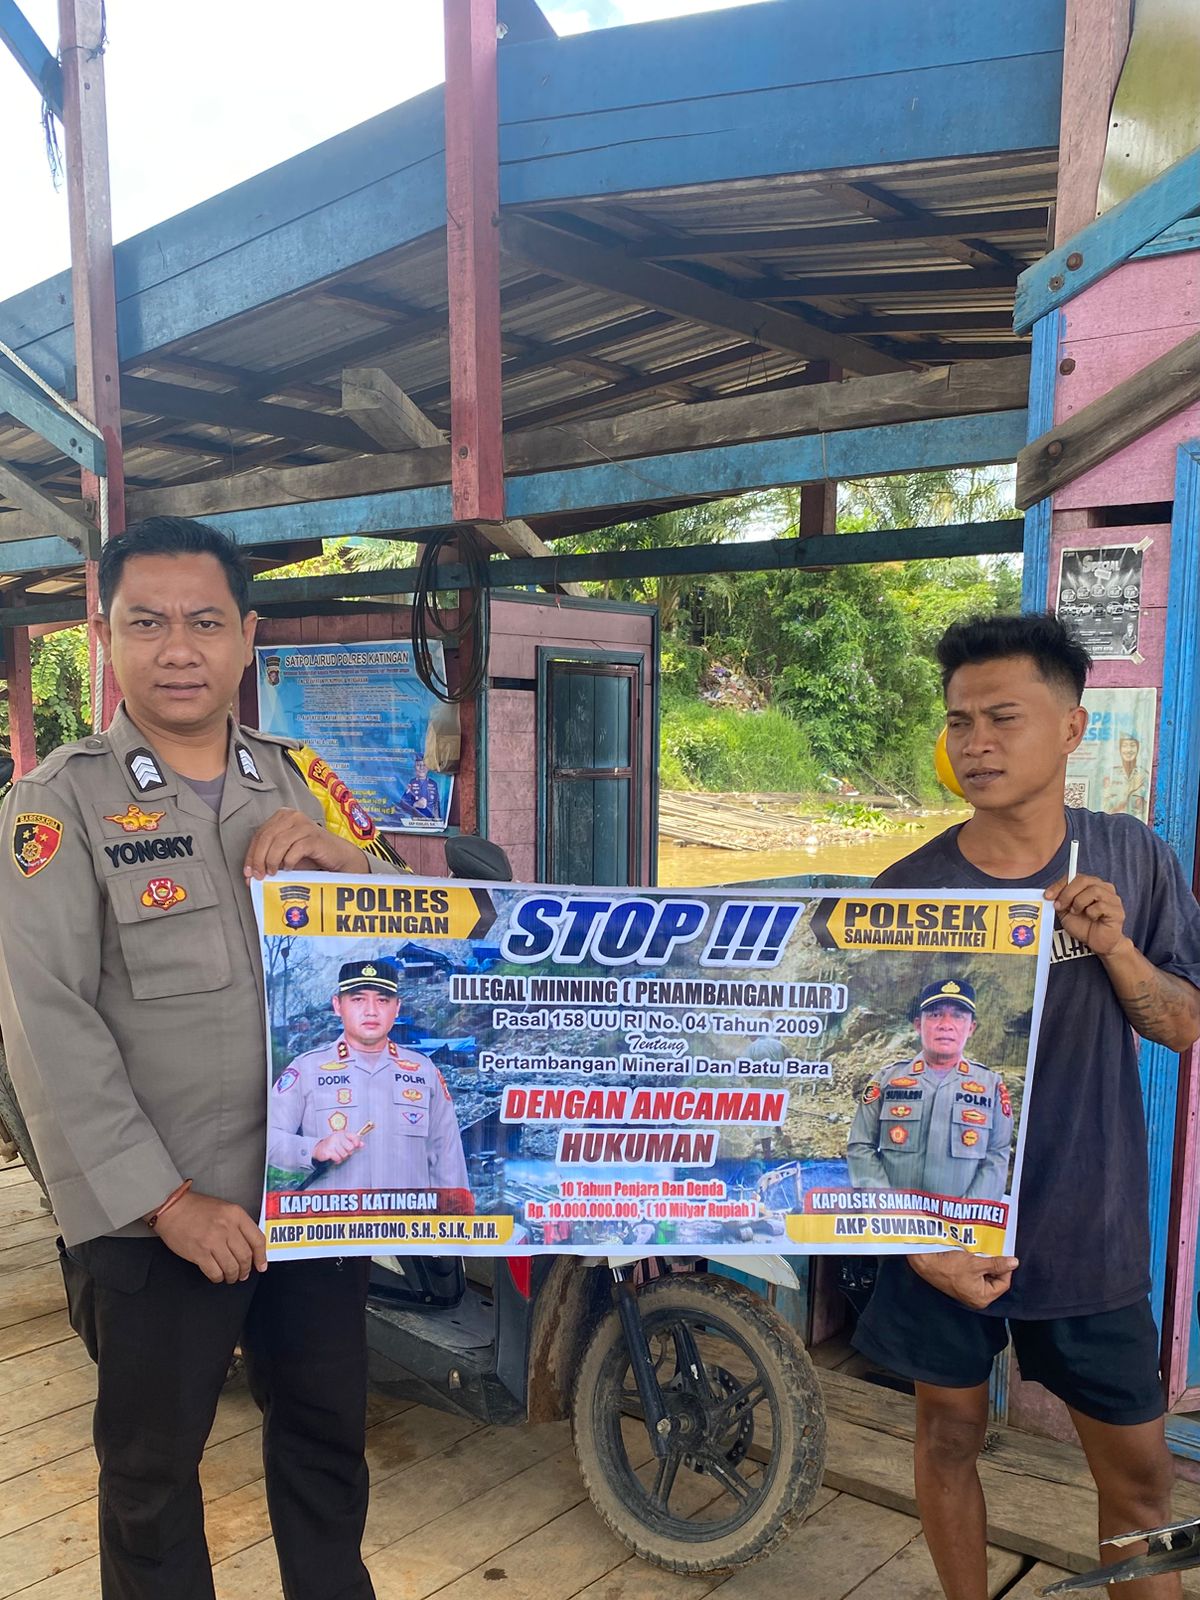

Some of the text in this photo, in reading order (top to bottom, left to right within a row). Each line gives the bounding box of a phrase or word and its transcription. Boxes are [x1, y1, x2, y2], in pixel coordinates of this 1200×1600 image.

[285, 651, 409, 667] SATPOLAIRUD POLRES KATINGAN
[104, 835, 193, 868] YONGKY
[336, 886, 449, 913] POLRES
[336, 914, 449, 935] KATINGAN
[844, 902, 989, 931] POLSEK
[505, 897, 802, 964] STOP !!!
[844, 928, 986, 948] SANAMAN MANTIKEI
[452, 977, 526, 1001] ILLEGAL
[531, 979, 618, 1003] MINNING
[635, 980, 784, 1008] PENAMBANGAN
[788, 985, 833, 1009] LIAR
[495, 1011, 820, 1034] Pasal 158 UU RI No. 04 Tahun 2009
[628, 1034, 686, 1055] Tentang
[482, 1055, 829, 1076] Pertambangan Mineral Dan Batu Bara
[317, 1074, 351, 1087] DODIK
[394, 1072, 426, 1086] POLRI
[504, 1089, 785, 1122] DENGAN ANCAMAN
[955, 1092, 992, 1107] POLRI
[559, 1132, 715, 1163] HUKUMAN
[560, 1181, 724, 1199] 10 Tahun Penjara Dan Denda
[280, 1192, 438, 1214] KAPOLRES KATINGAN
[527, 1203, 546, 1221] Rp.
[654, 1203, 667, 1219] 10
[669, 1202, 706, 1221] Milyar
[707, 1202, 750, 1221] Rupiah
[812, 1192, 1005, 1224] KAPOLSEK SANAMAN MANTIKEI
[269, 1221, 499, 1243] AKBP DODIK HARTONO, S.H., S.I.K., M.H.
[835, 1217, 977, 1245] AKP SUWARDI, S.H.
